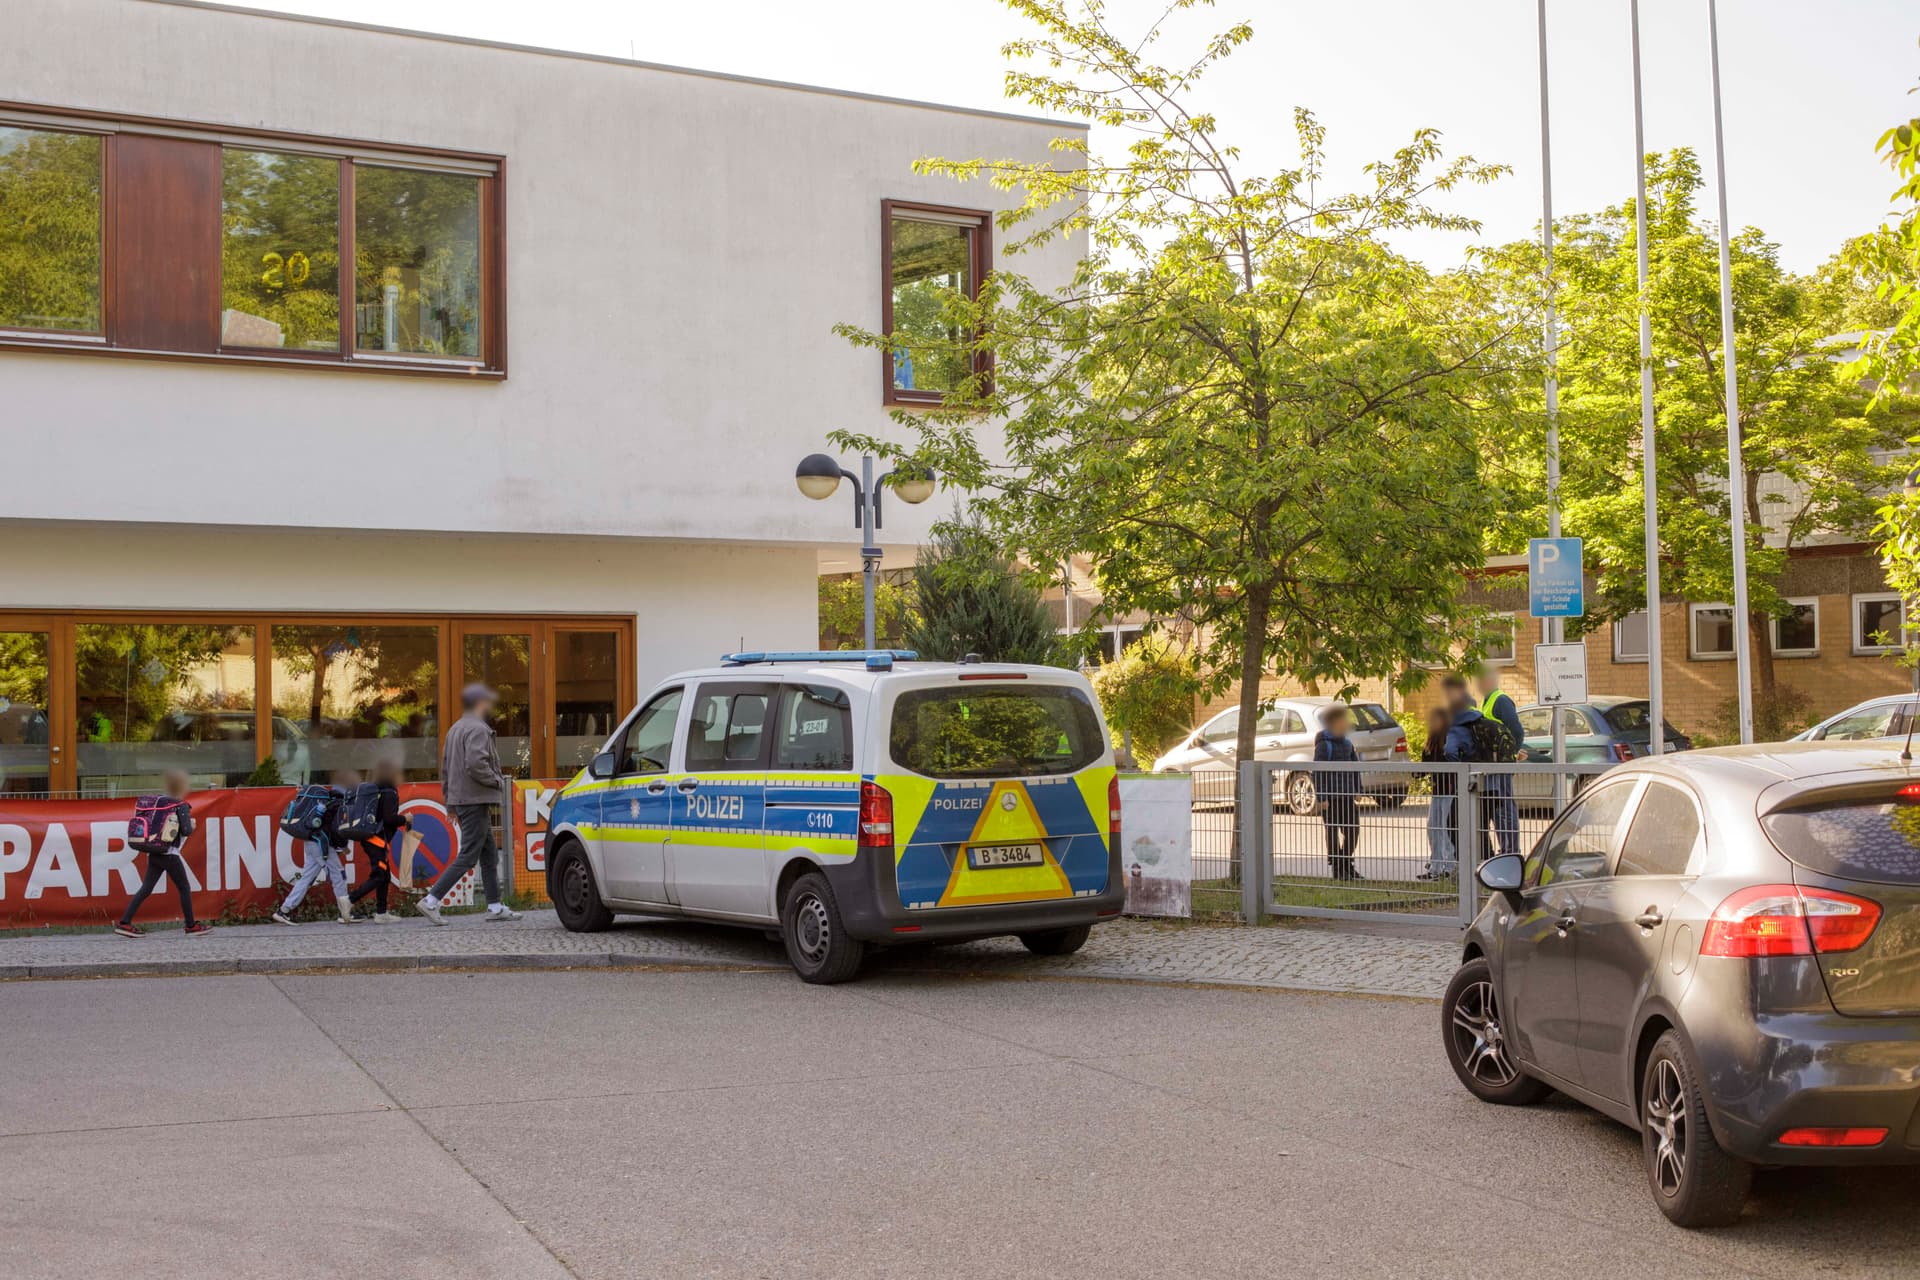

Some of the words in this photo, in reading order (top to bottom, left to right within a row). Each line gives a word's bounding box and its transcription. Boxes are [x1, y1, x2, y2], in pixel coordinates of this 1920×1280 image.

[262, 251, 309, 288] 20
[864, 560, 880, 572] 27
[1538, 543, 1560, 575] P
[686, 794, 744, 820] POLIZEI
[934, 798, 982, 810] POLIZEI
[816, 813, 833, 828] 110
[981, 849, 991, 863] B
[1000, 847, 1031, 862] 3484
[1829, 968, 1860, 977] RIO
